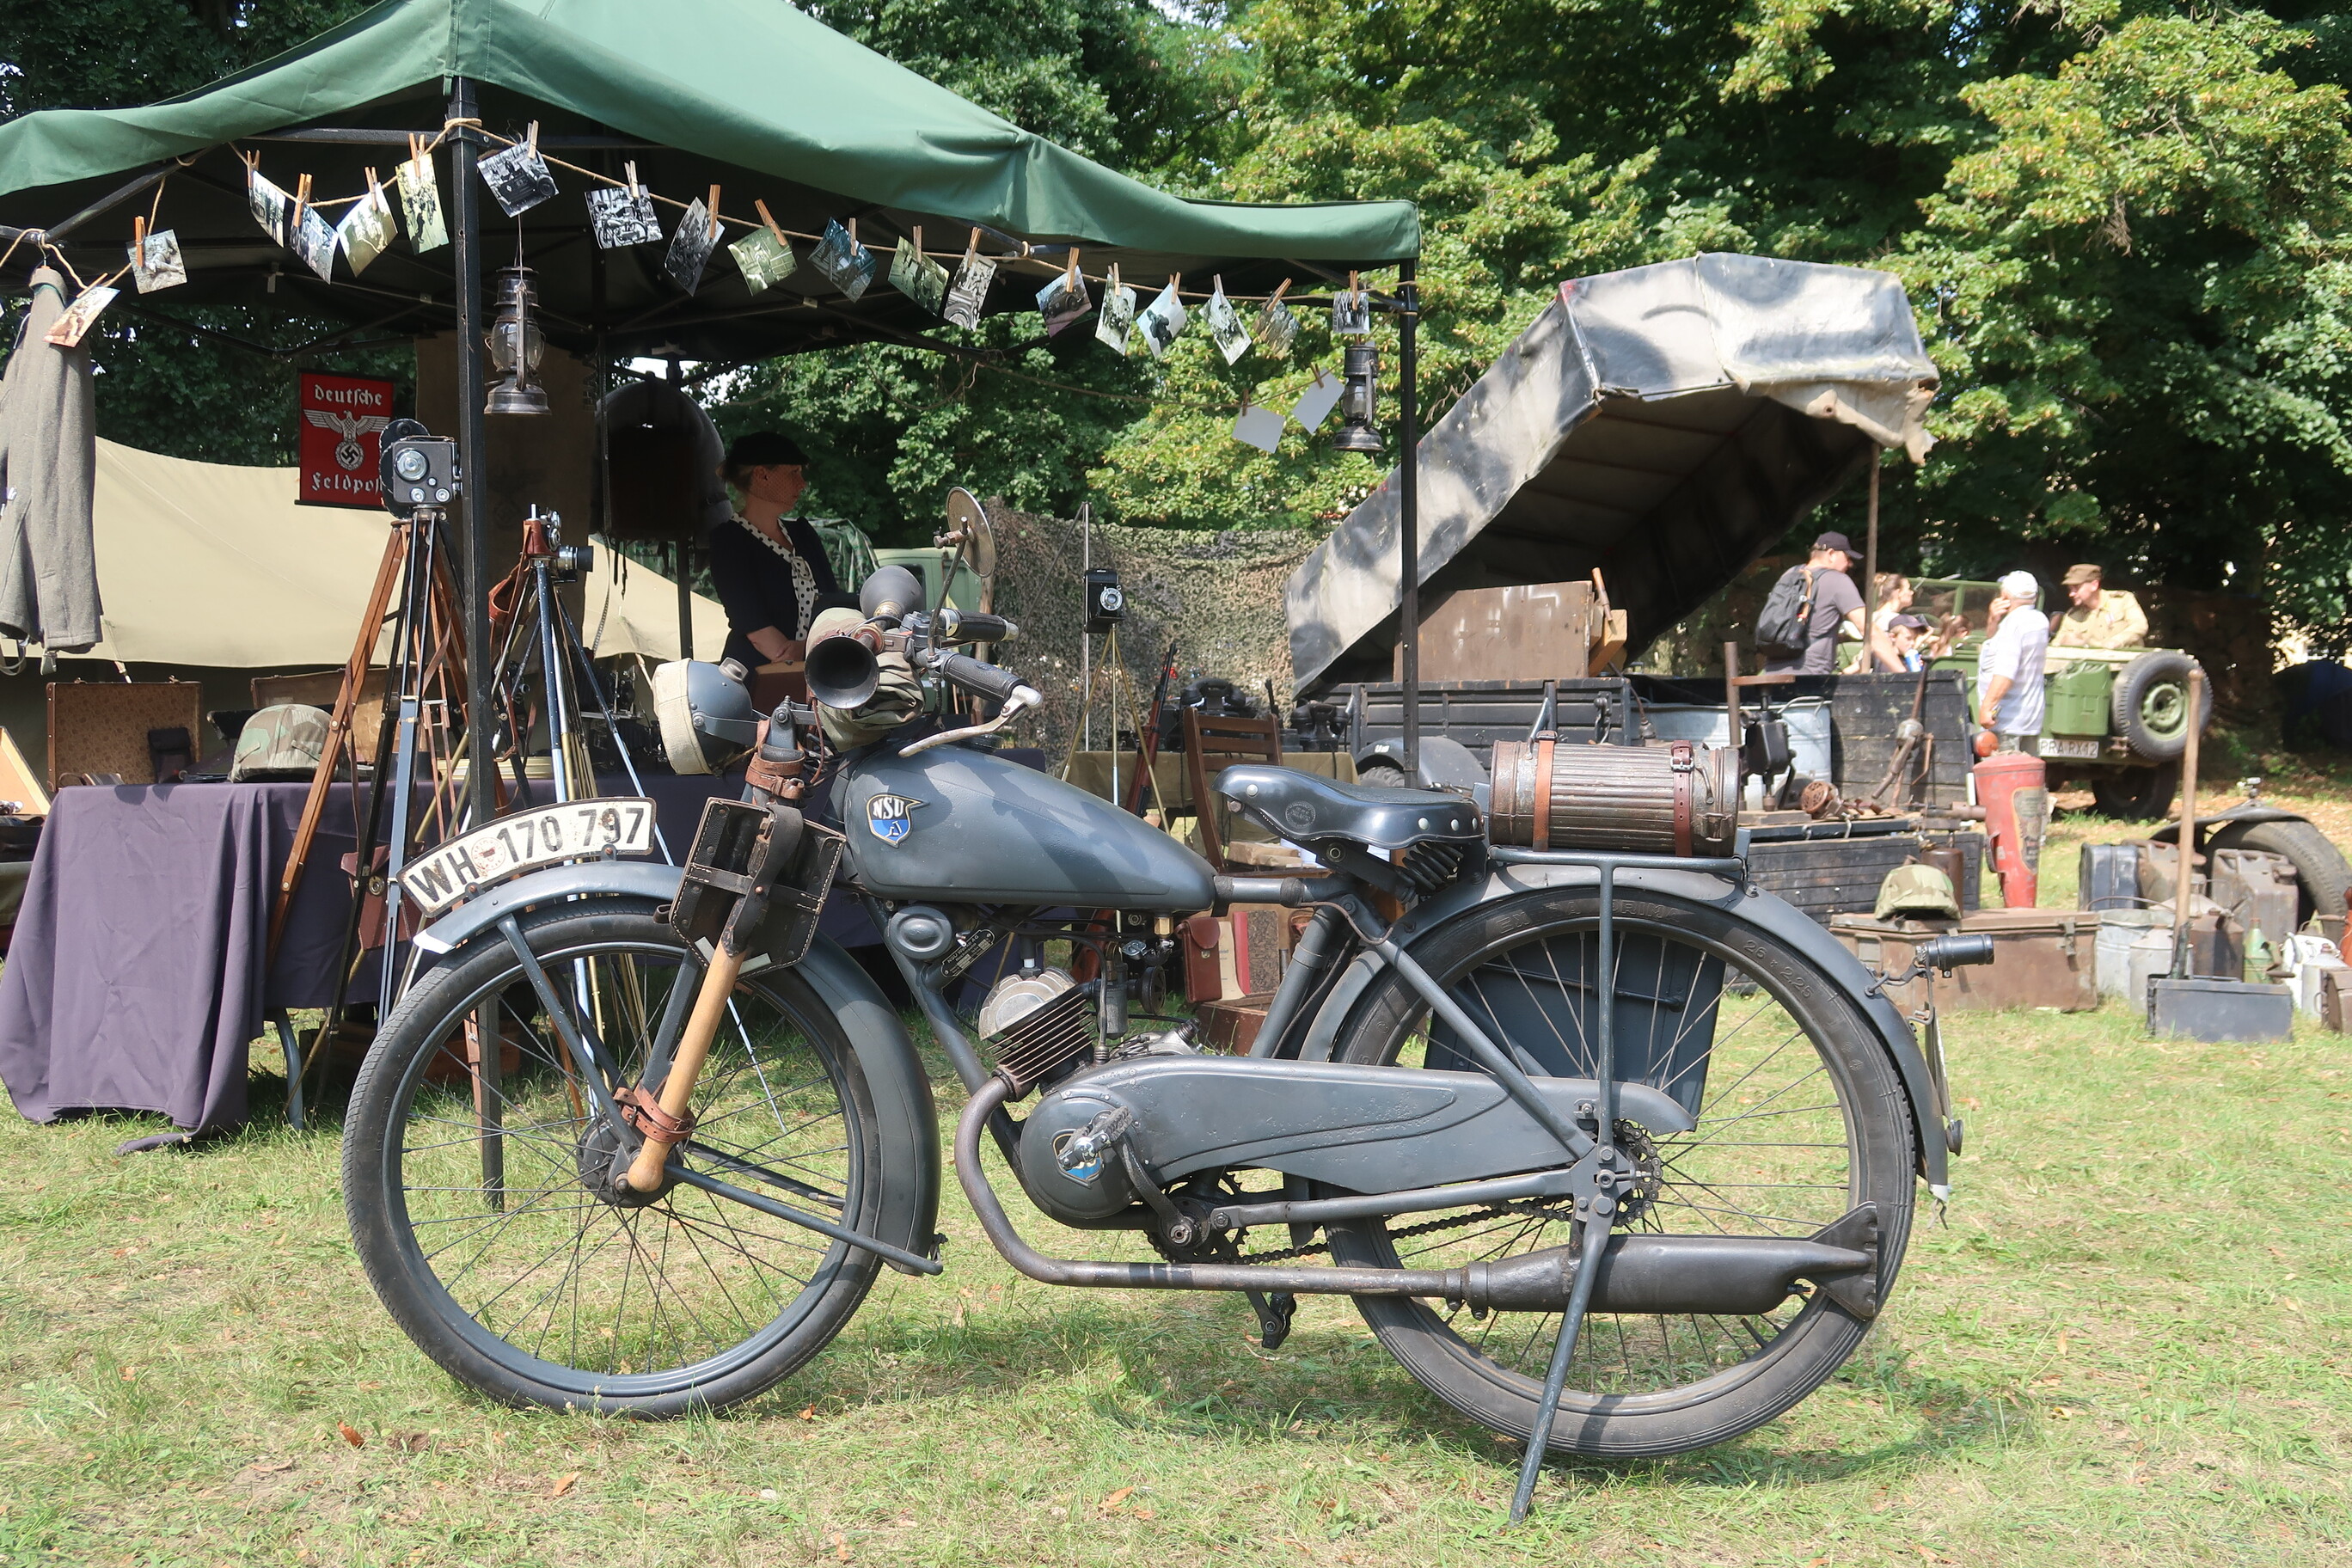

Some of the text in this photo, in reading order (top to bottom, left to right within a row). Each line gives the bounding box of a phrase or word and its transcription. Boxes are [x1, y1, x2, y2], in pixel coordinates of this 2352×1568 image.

[311, 471, 383, 494] Feldpos
[2041, 740, 2064, 754] PRA
[873, 796, 905, 819] NSU
[408, 845, 479, 903] WH
[497, 816, 563, 863] 170
[578, 807, 645, 847] 797
[1743, 940, 1767, 959] 26
